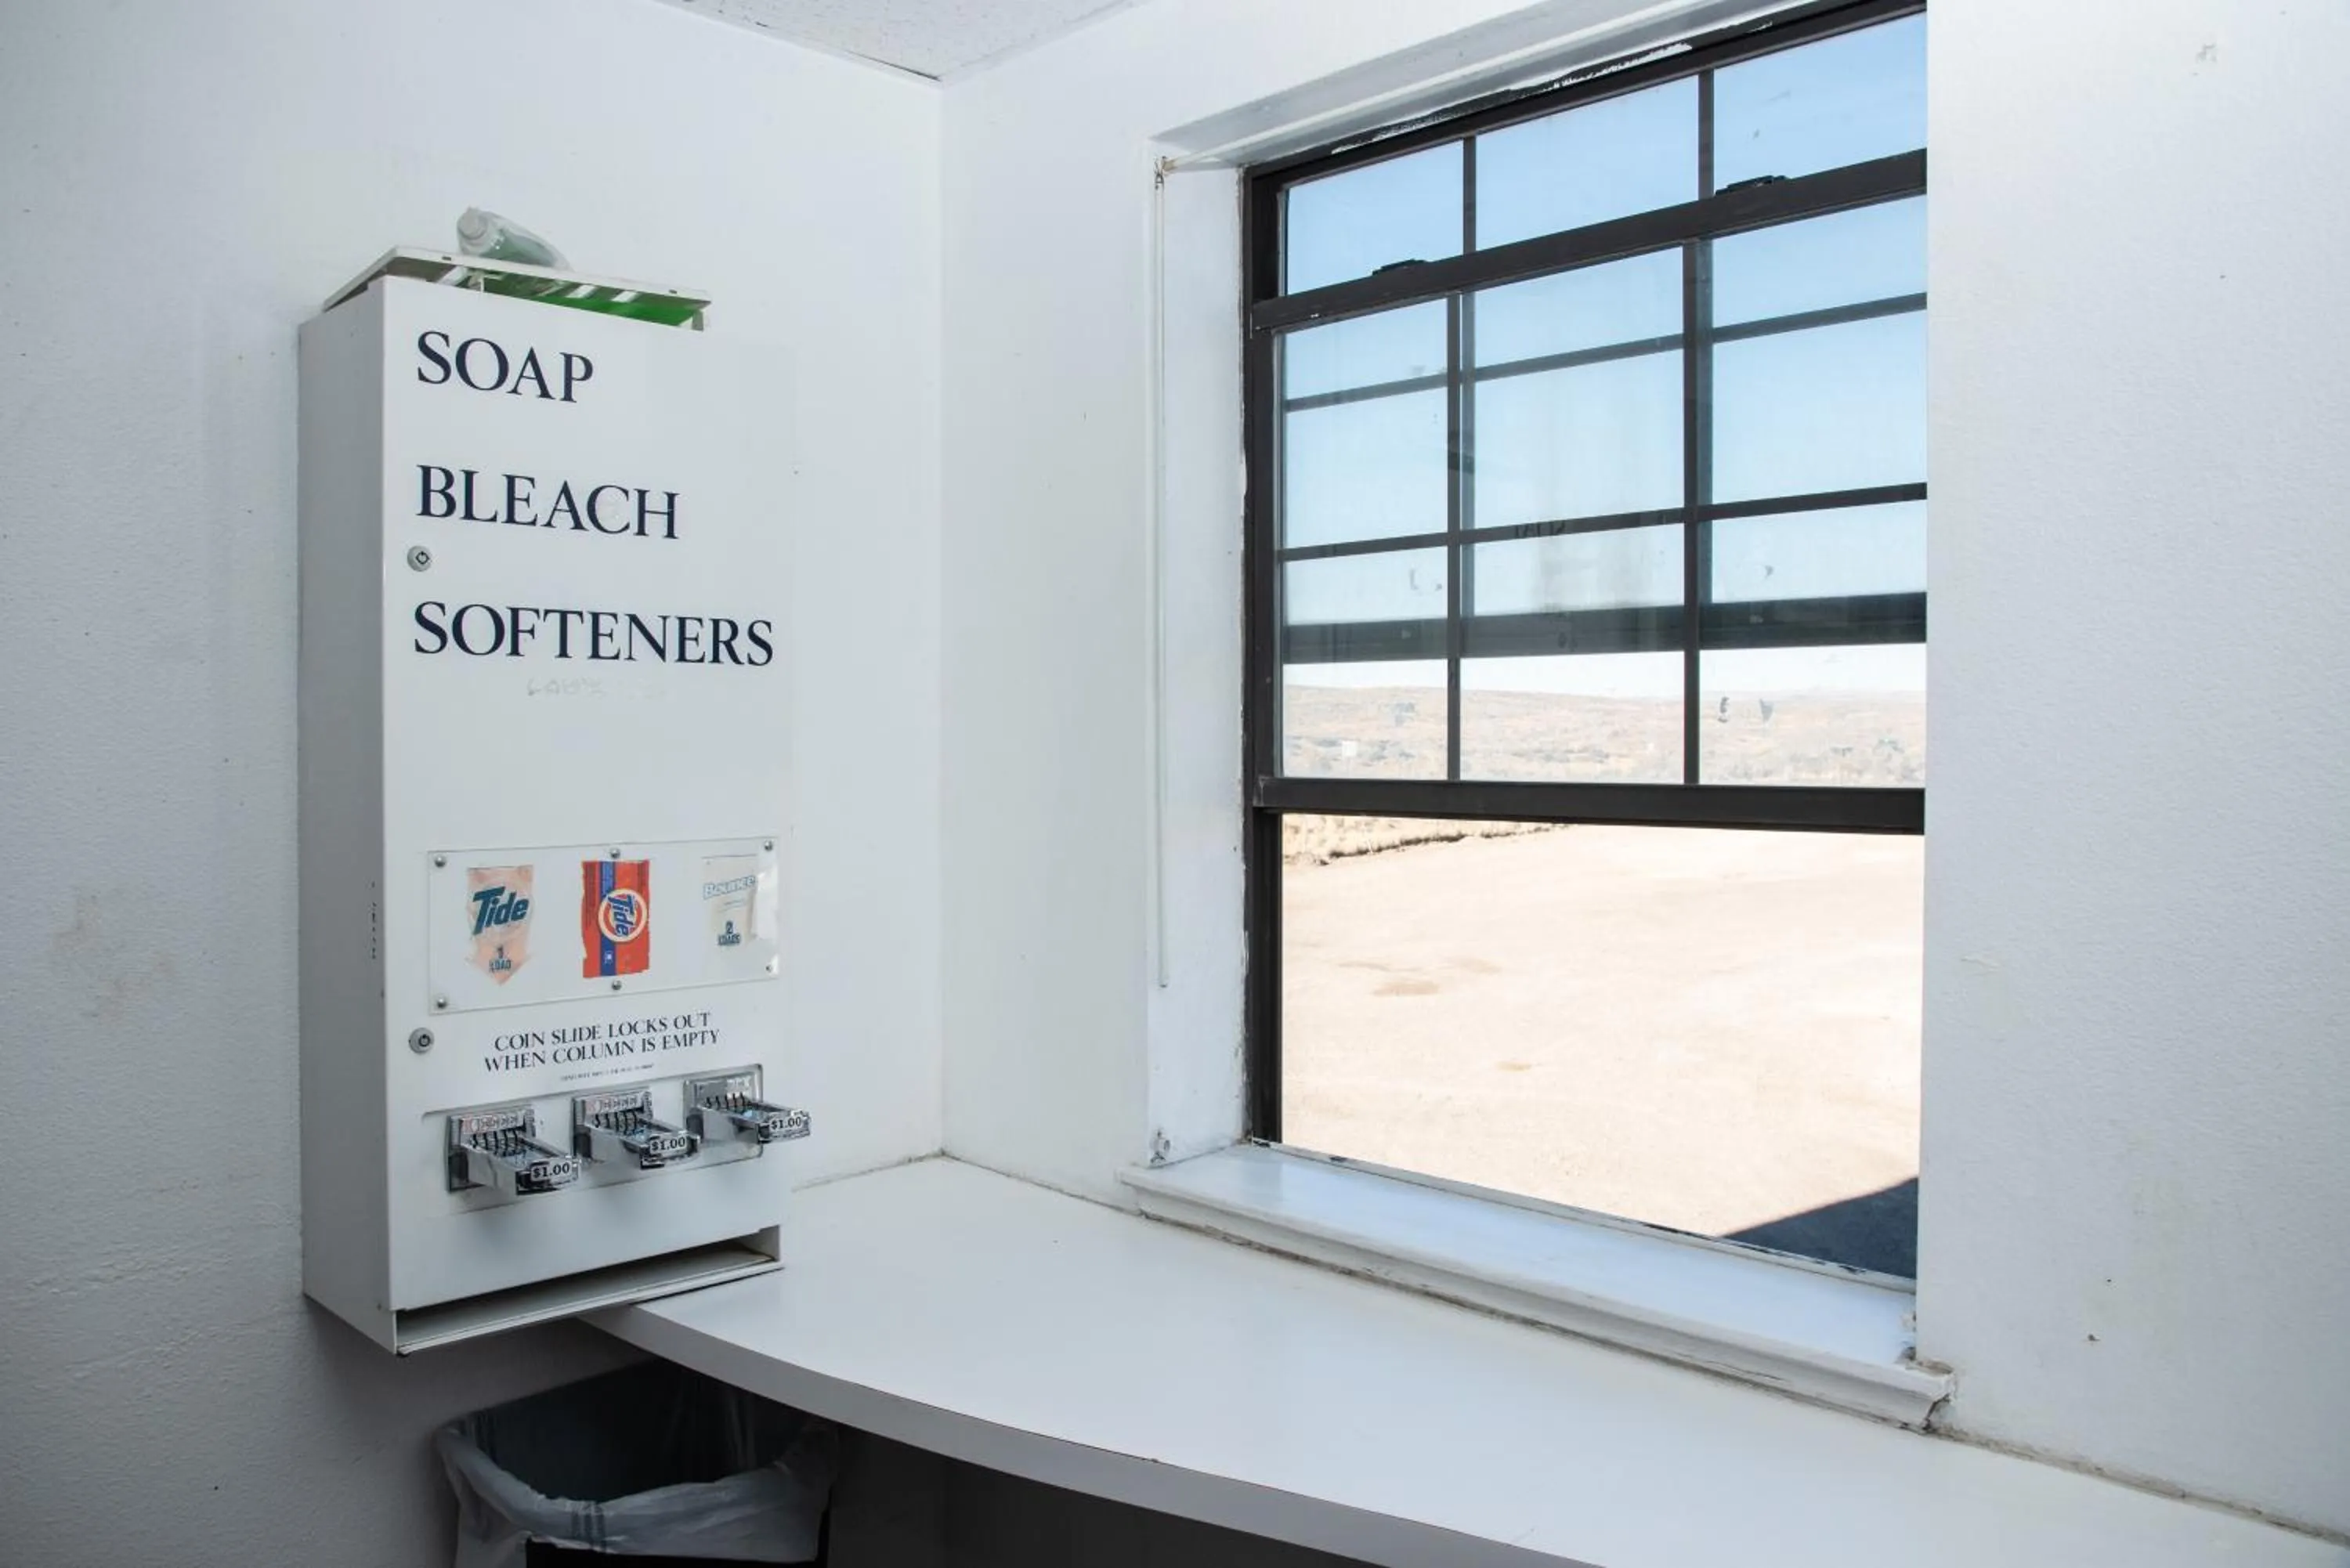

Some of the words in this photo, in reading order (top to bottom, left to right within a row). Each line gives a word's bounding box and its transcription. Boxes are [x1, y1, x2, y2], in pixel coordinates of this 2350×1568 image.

[417, 331, 594, 403] SOAP
[416, 464, 680, 540] BLEACH
[413, 601, 774, 667] SOFTENERS
[472, 886, 530, 936] Tide
[607, 894, 636, 938] Tide
[725, 920, 734, 934] 2
[484, 1050, 546, 1072] WHEN
[552, 1039, 635, 1065] COLUMN
[641, 1036, 656, 1053] IS
[663, 1028, 720, 1050] EMPTY
[494, 1031, 545, 1052] COIN
[551, 1024, 602, 1045] SLIDE
[608, 1017, 667, 1039] LOCKS
[673, 1011, 711, 1029] OUT
[651, 1136, 687, 1151] $1.00
[770, 1115, 803, 1130] $1.00
[532, 1162, 570, 1179] $1.00
